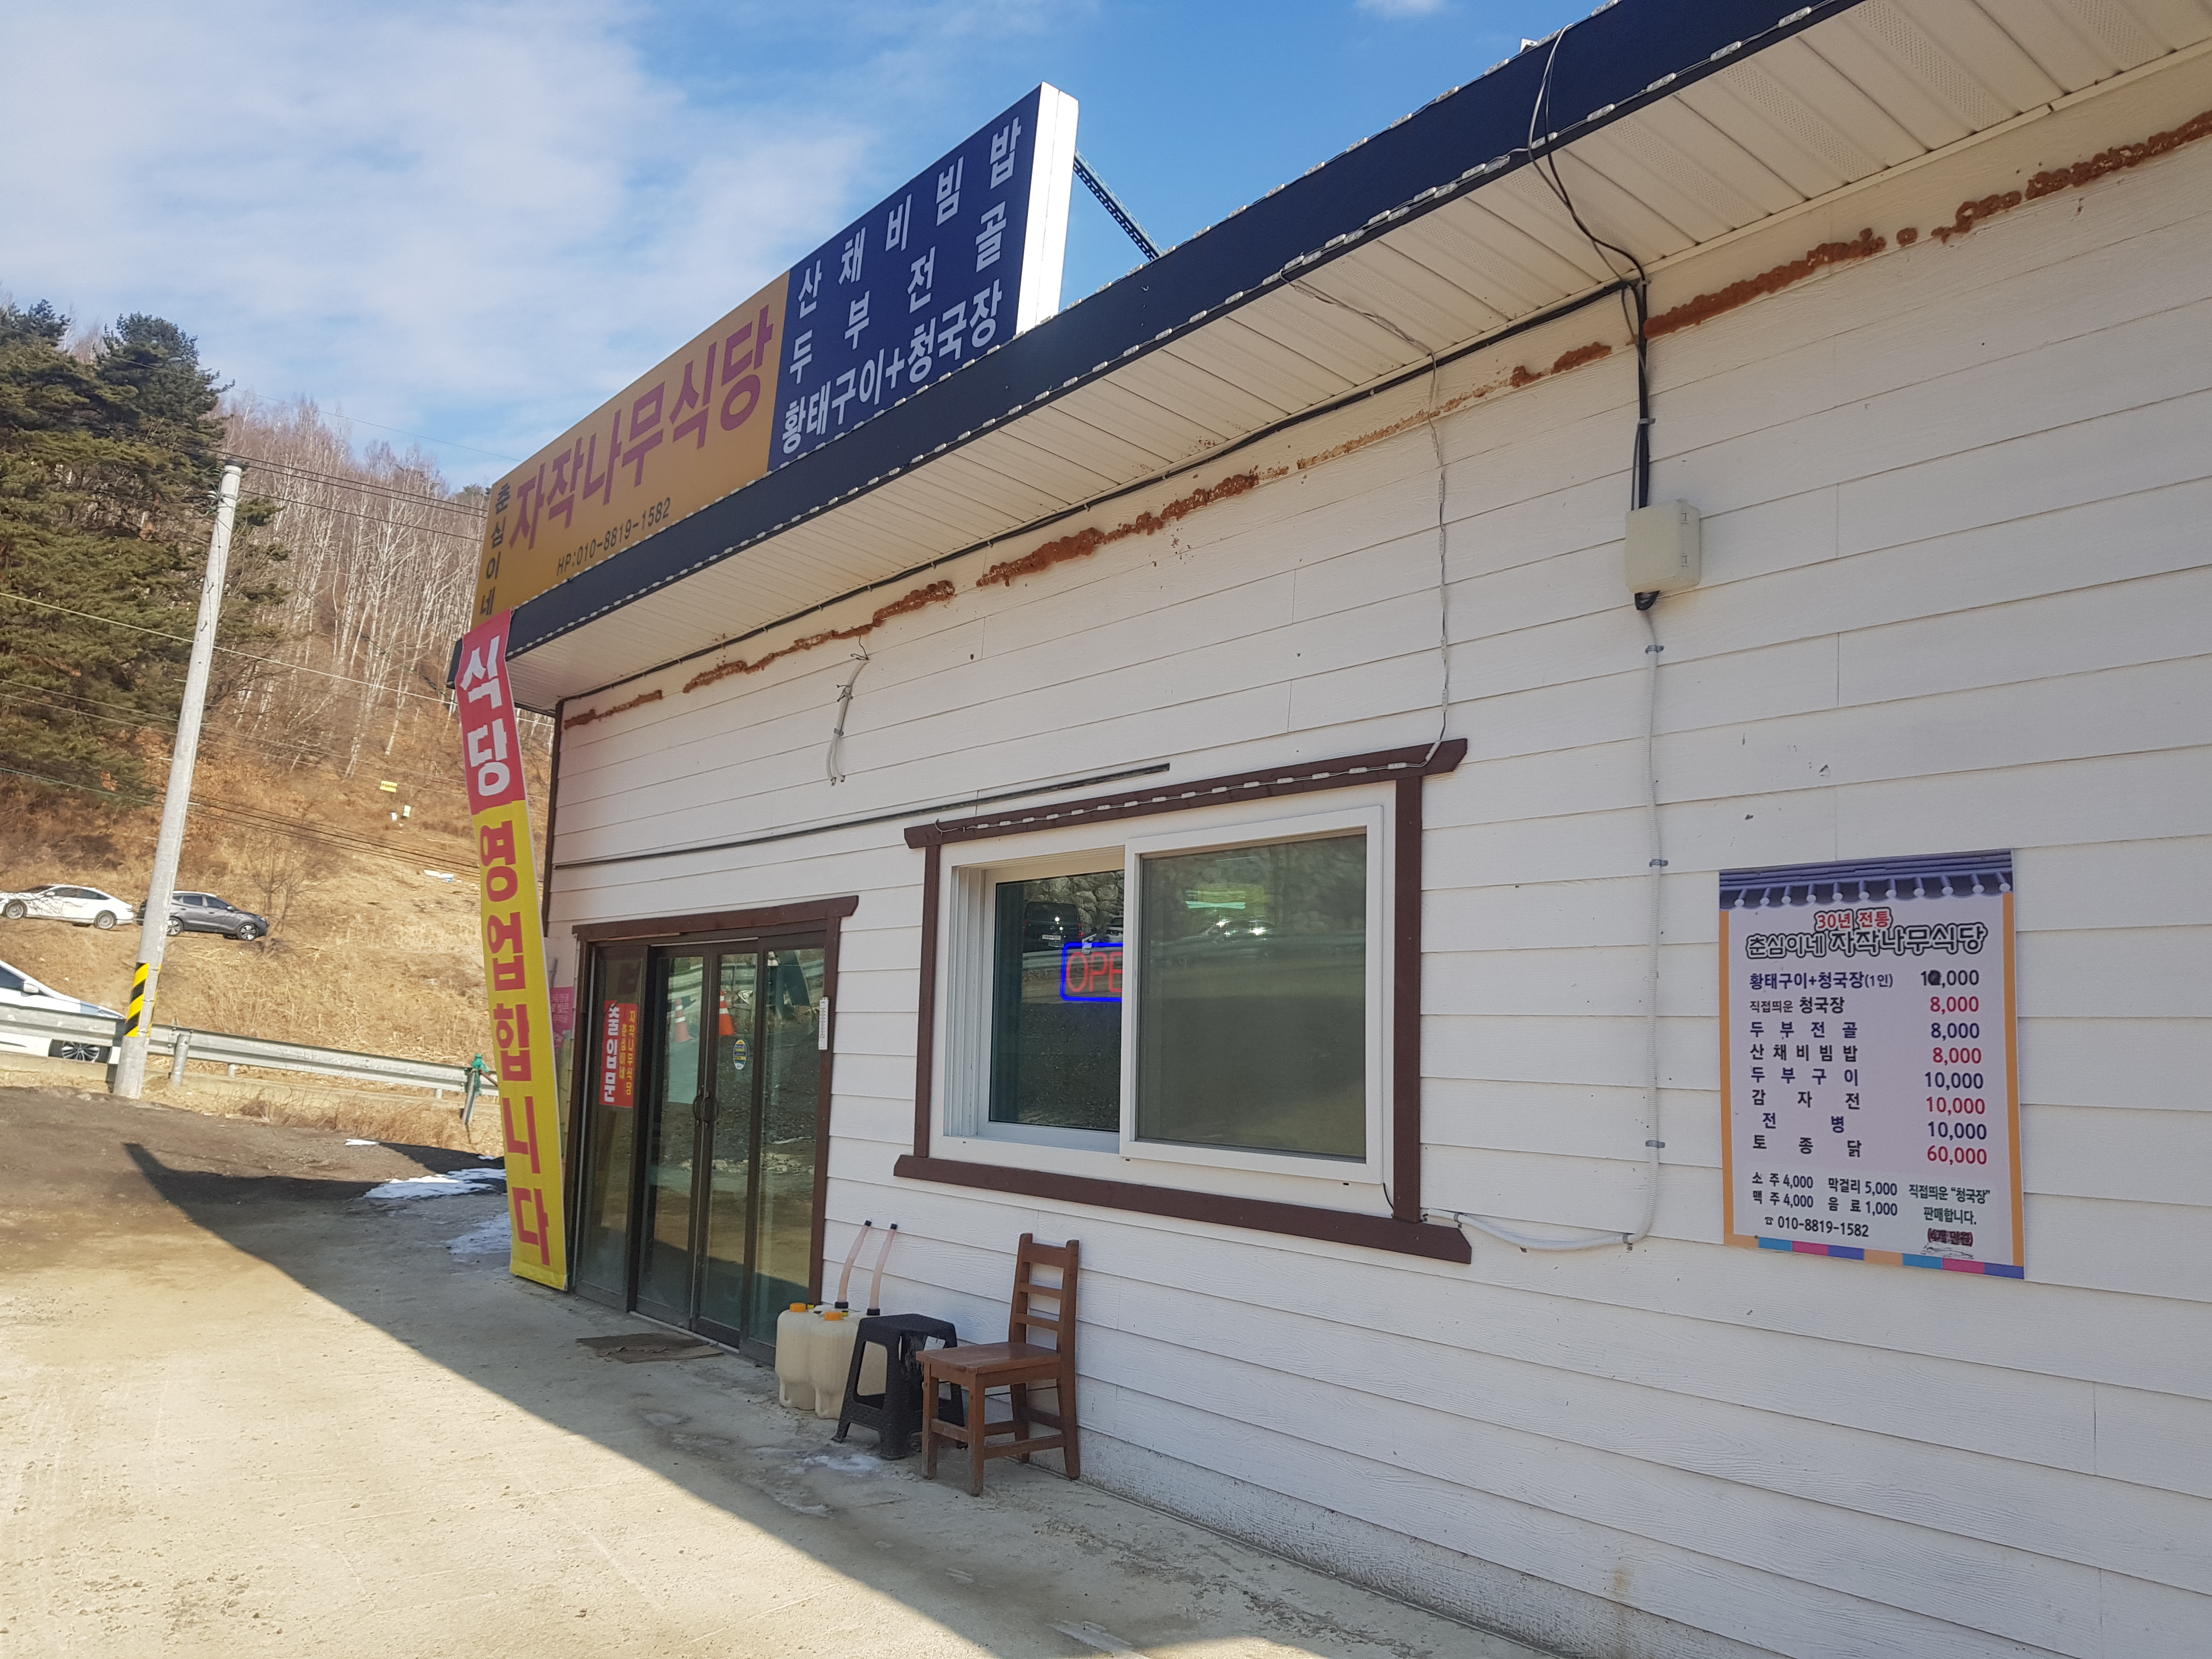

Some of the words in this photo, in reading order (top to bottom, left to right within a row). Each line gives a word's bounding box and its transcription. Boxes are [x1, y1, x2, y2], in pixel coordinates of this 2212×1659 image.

[782, 279, 1003, 454] 황태구이+청국장
[509, 303, 774, 550] 자작나무식당
[479, 483, 511, 616] 춘심이네
[460, 635, 510, 797] 식당
[1817, 912, 1851, 929] 30년
[1859, 911, 1889, 928] 전통
[1747, 934, 1825, 957] 춘심이네
[1830, 924, 1986, 956] 자작나무식당
[1920, 969, 1979, 988] 1,000
[1750, 1000, 1793, 1013] 직접띄운
[1799, 996, 1844, 1014] 청국장
[1930, 996, 1979, 1014] 8,000
[1931, 1022, 1980, 1041] 8,000
[480, 820, 550, 1266] 영업합니다
[1932, 1047, 1982, 1066] 8,000
[1925, 1071, 1984, 1091] 10,000
[1926, 1096, 1985, 1116] 10,000
[1927, 1121, 1987, 1141] 10,000
[1927, 1145, 1987, 1165] 60,000
[1782, 1174, 1813, 1189] 4,000
[1828, 1177, 1860, 1194] 막걸리
[1865, 1181, 1898, 1196] 5,000
[1909, 1184, 1948, 1200] 직접띄운
[1783, 1193, 1814, 1208] 4,000
[1866, 1201, 1898, 1216] 1,000
[1923, 1206, 1977, 1225] 판매합니다.
[1778, 1216, 1869, 1237] 010-8819-1582
